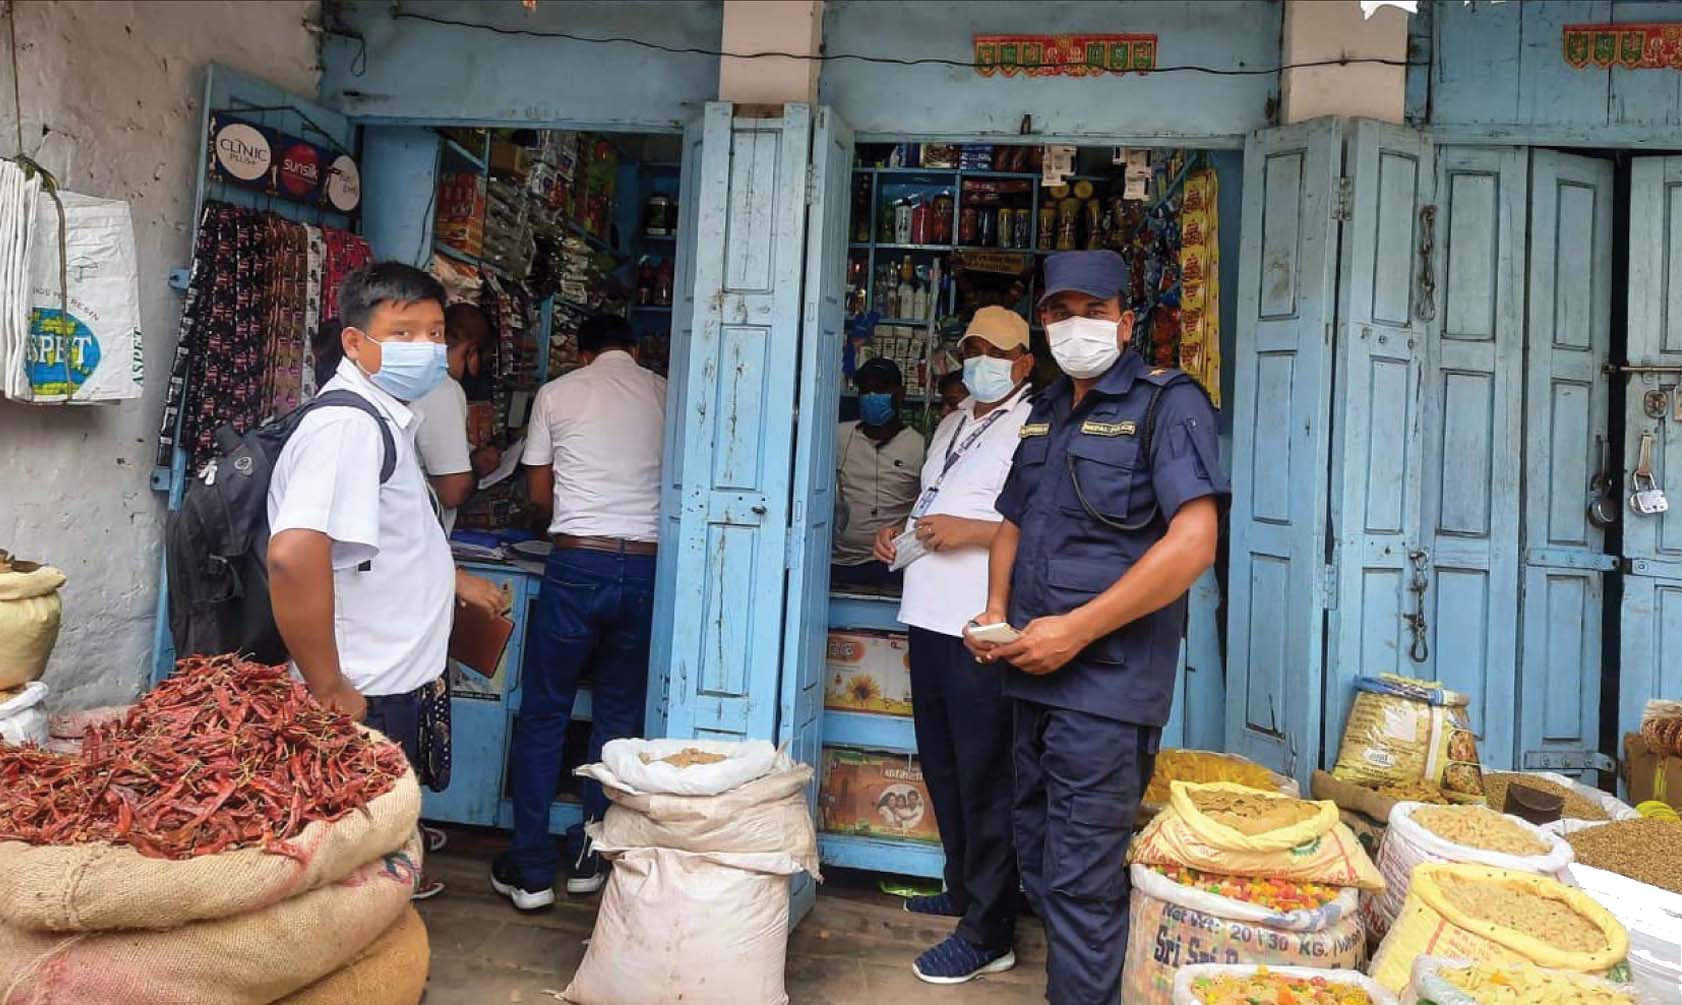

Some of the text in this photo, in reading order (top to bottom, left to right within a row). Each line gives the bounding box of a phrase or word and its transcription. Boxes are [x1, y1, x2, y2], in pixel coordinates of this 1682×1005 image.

[220, 138, 268, 162] CLINIC
[27, 334, 92, 364] SPET
[132, 327, 144, 387] ASPET
[1154, 925, 1181, 968] Sri
[1230, 923, 1252, 943] 20
[1267, 933, 1289, 951] 30
